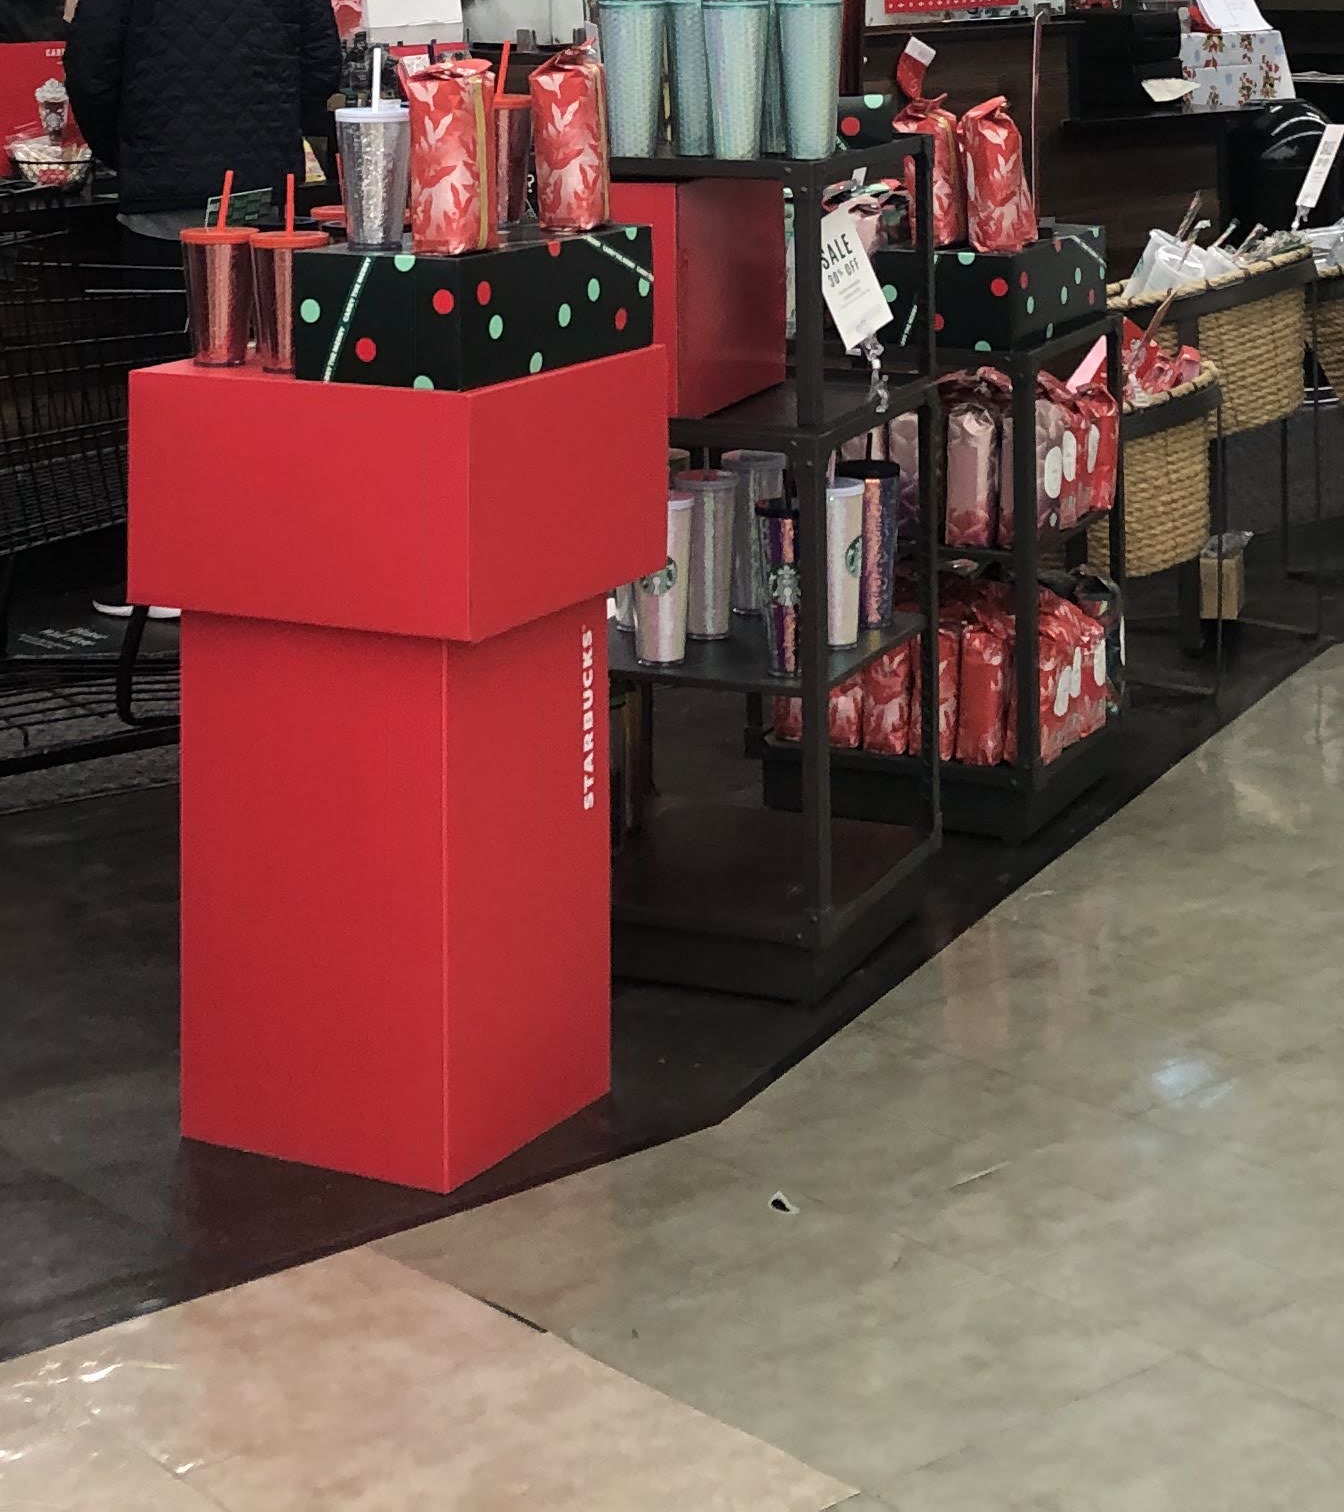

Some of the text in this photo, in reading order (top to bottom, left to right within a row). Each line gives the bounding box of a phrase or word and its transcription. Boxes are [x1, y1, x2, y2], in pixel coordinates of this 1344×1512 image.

[821, 233, 853, 270] SALE
[844, 257, 860, 276] OFF
[582, 630, 595, 810] STARBUCKS
